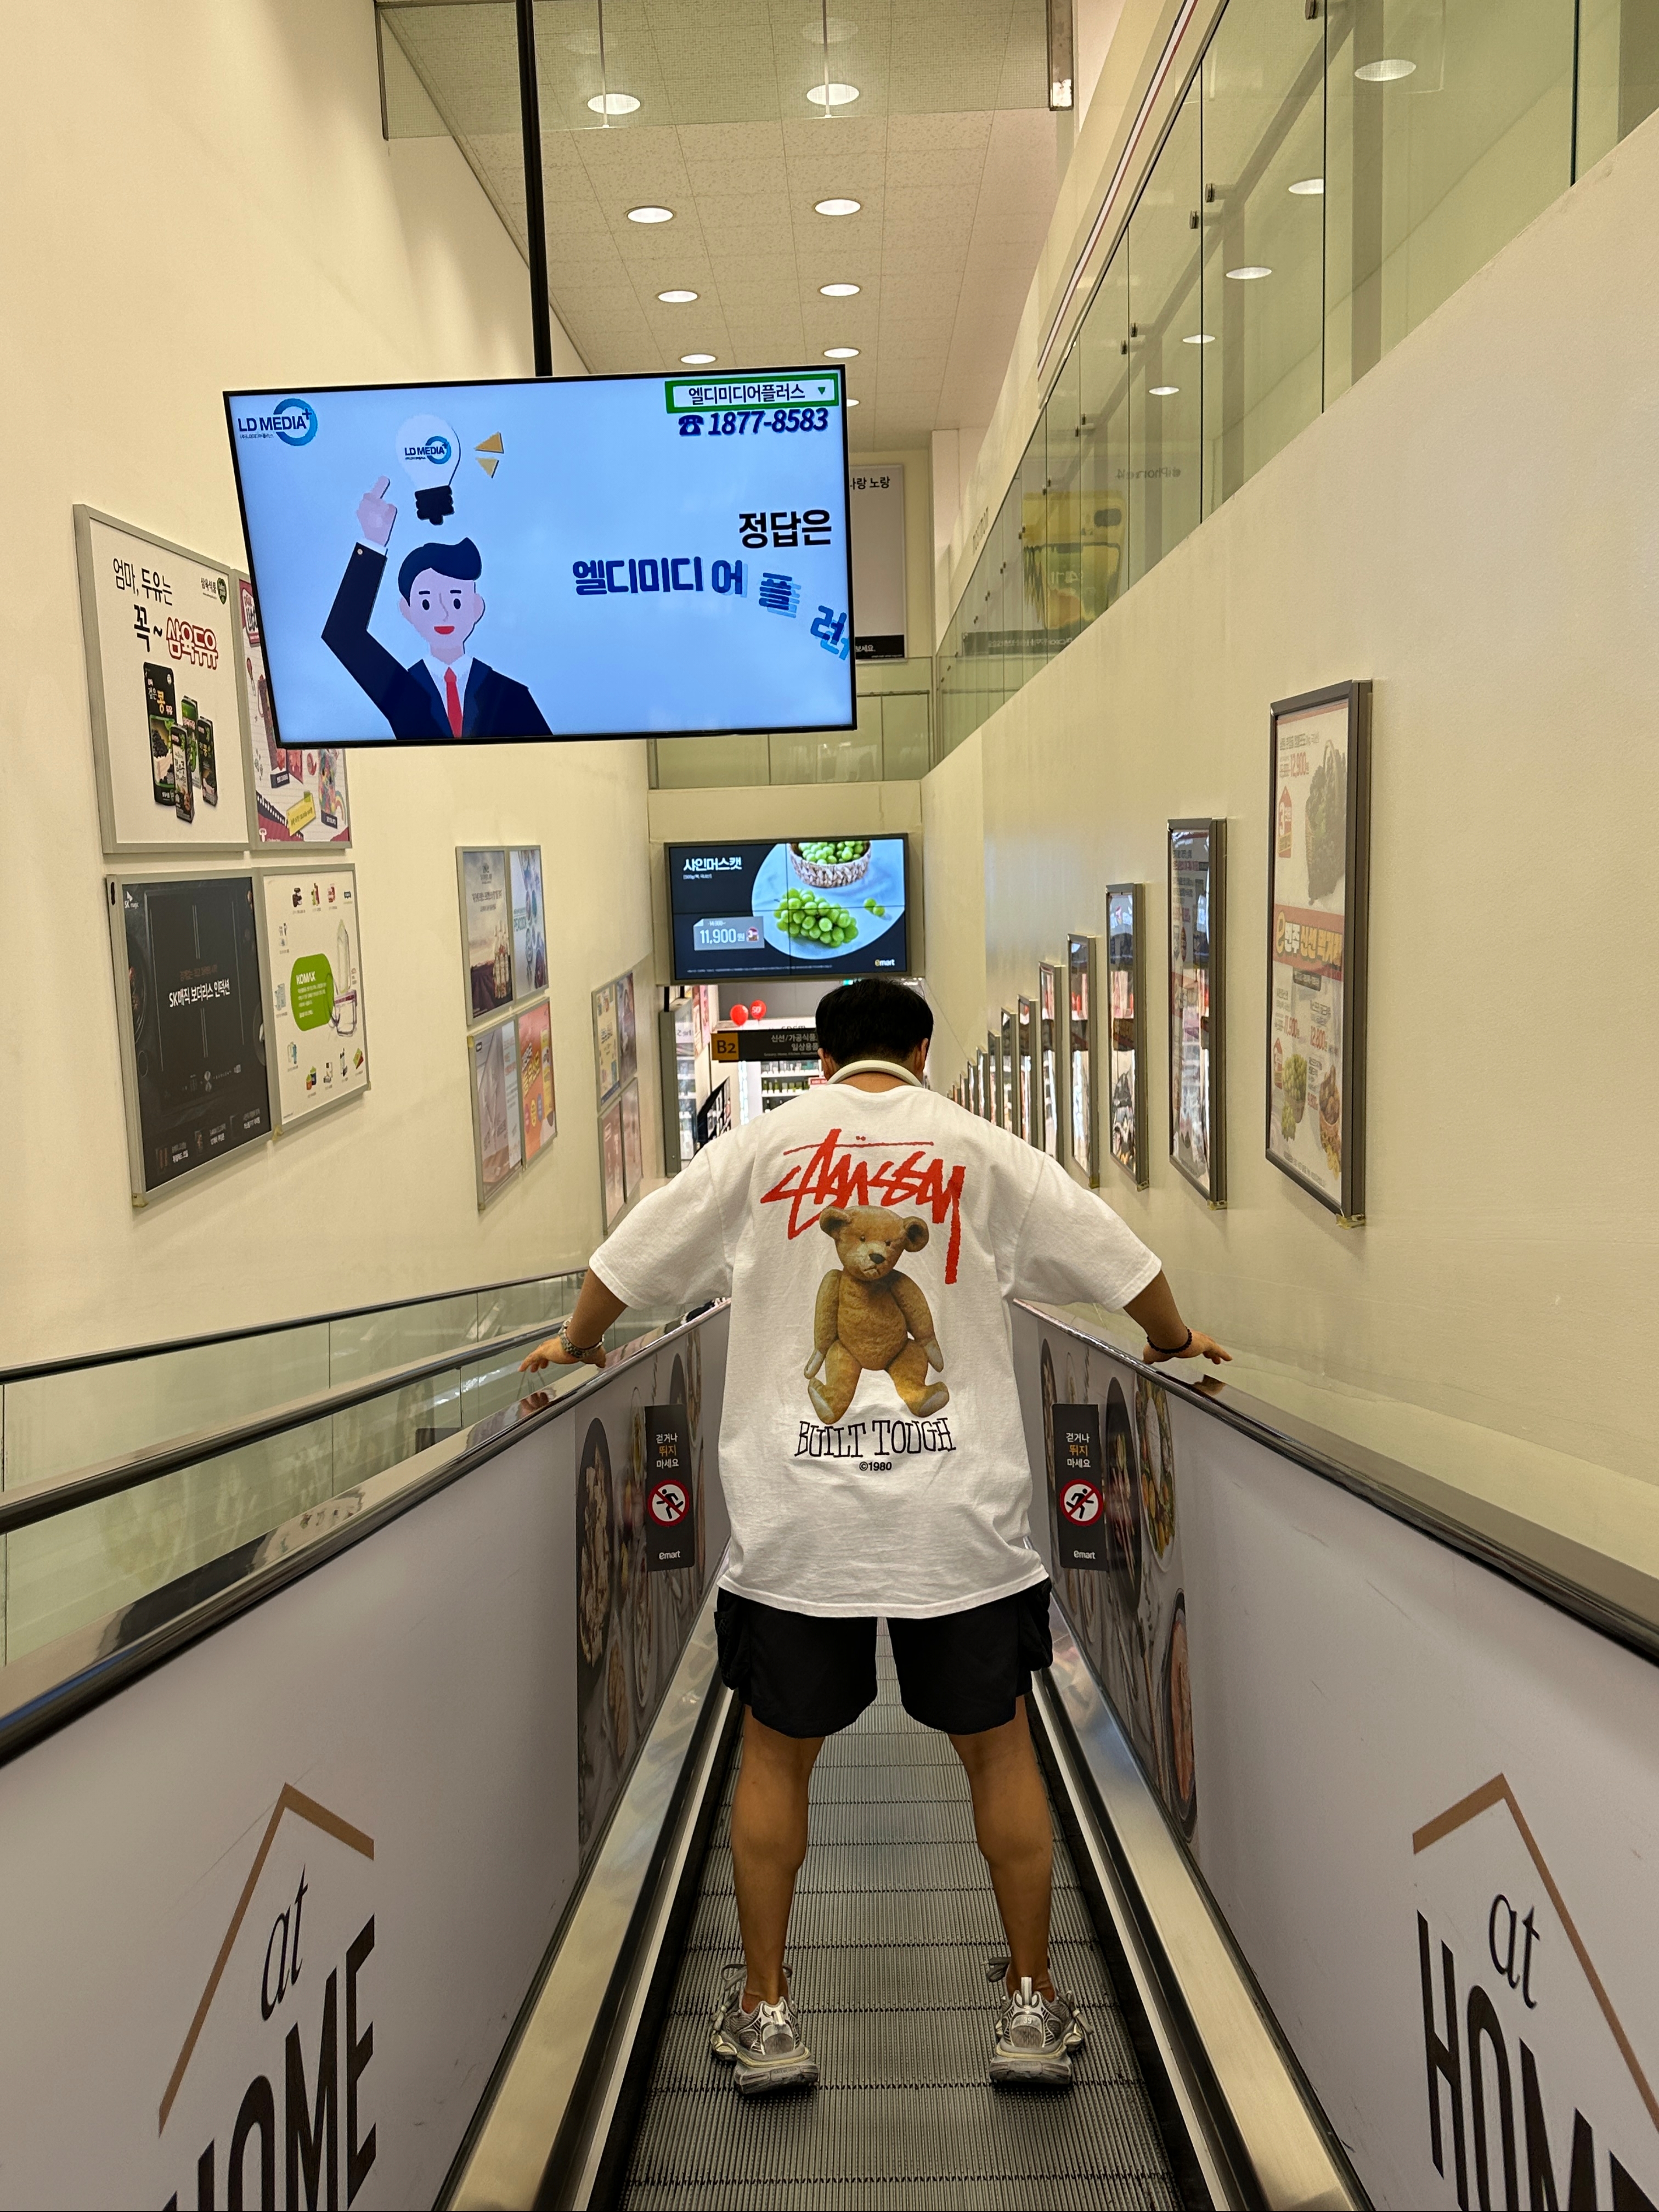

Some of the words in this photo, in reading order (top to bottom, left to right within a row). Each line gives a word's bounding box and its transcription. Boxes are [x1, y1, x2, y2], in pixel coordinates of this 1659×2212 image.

[688, 383, 805, 405] 엘디미디어플러스
[238, 417, 257, 432] LD
[708, 408, 829, 436] 1877-8583
[404, 447, 416, 456] LD
[870, 476, 890, 489] 노랑
[739, 509, 832, 549] 정답은
[113, 558, 139, 596] 엄마,
[142, 568, 172, 606] 두유는
[201, 577, 217, 594] 삼육식품
[166, 617, 218, 670] 삼육두유
[683, 856, 742, 872] 샤인머스캣
[296, 971, 316, 985] KOMAX
[169, 986, 190, 1007] SK매직
[191, 983, 213, 1002] 보더리스
[213, 978, 230, 997] 인덕션
[716, 1040, 737, 1054] B2
[791, 1042, 819, 1052] 일상용품
[656, 1432, 678, 1444] 걷거나
[794, 1420, 866, 1458] BUILT
[872, 1417, 956, 1455] TOUGH
[1066, 1432, 1090, 1443] 걷거나
[659, 1444, 677, 1457] 뛰지
[1069, 1444, 1088, 1457] 뛰지
[656, 1458, 680, 1469] 마세요
[1067, 1458, 1091, 1469] 마세요
[659, 1550, 681, 1560] emart
[1073, 1550, 1096, 1560] emart
[261, 1863, 308, 2022] at
[1489, 1893, 1541, 2010] at
[1023, 2016, 1032, 2024] 39
[1417, 1909, 1659, 2211] HO
